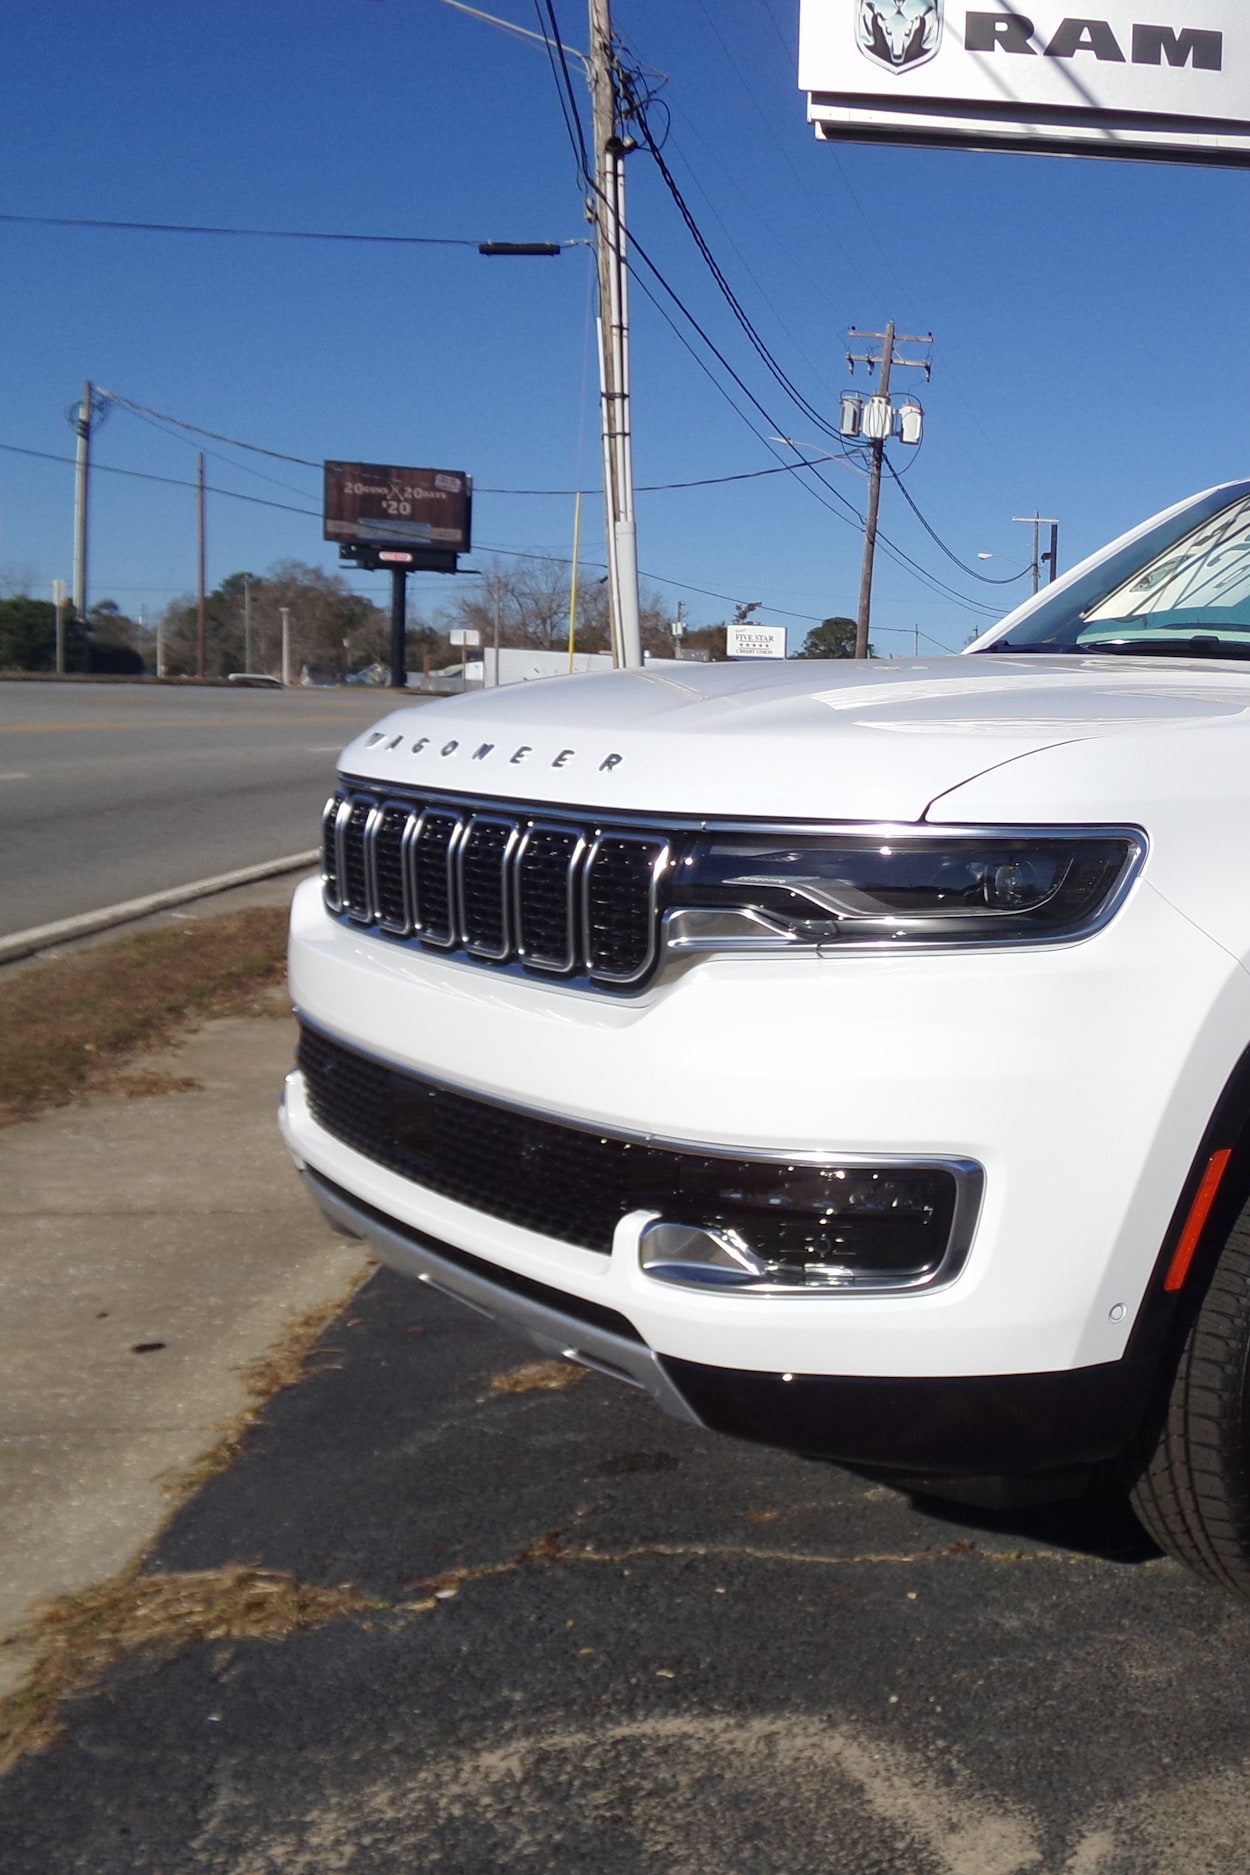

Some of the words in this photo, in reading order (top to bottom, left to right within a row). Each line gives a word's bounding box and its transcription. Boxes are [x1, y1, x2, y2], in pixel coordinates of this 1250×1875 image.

[965, 11, 1223, 71] RAM
[381, 500, 412, 515] $20
[736, 633, 754, 641] FIVE
[754, 634, 774, 642] STAR
[365, 732, 624, 773] WAGONEER
